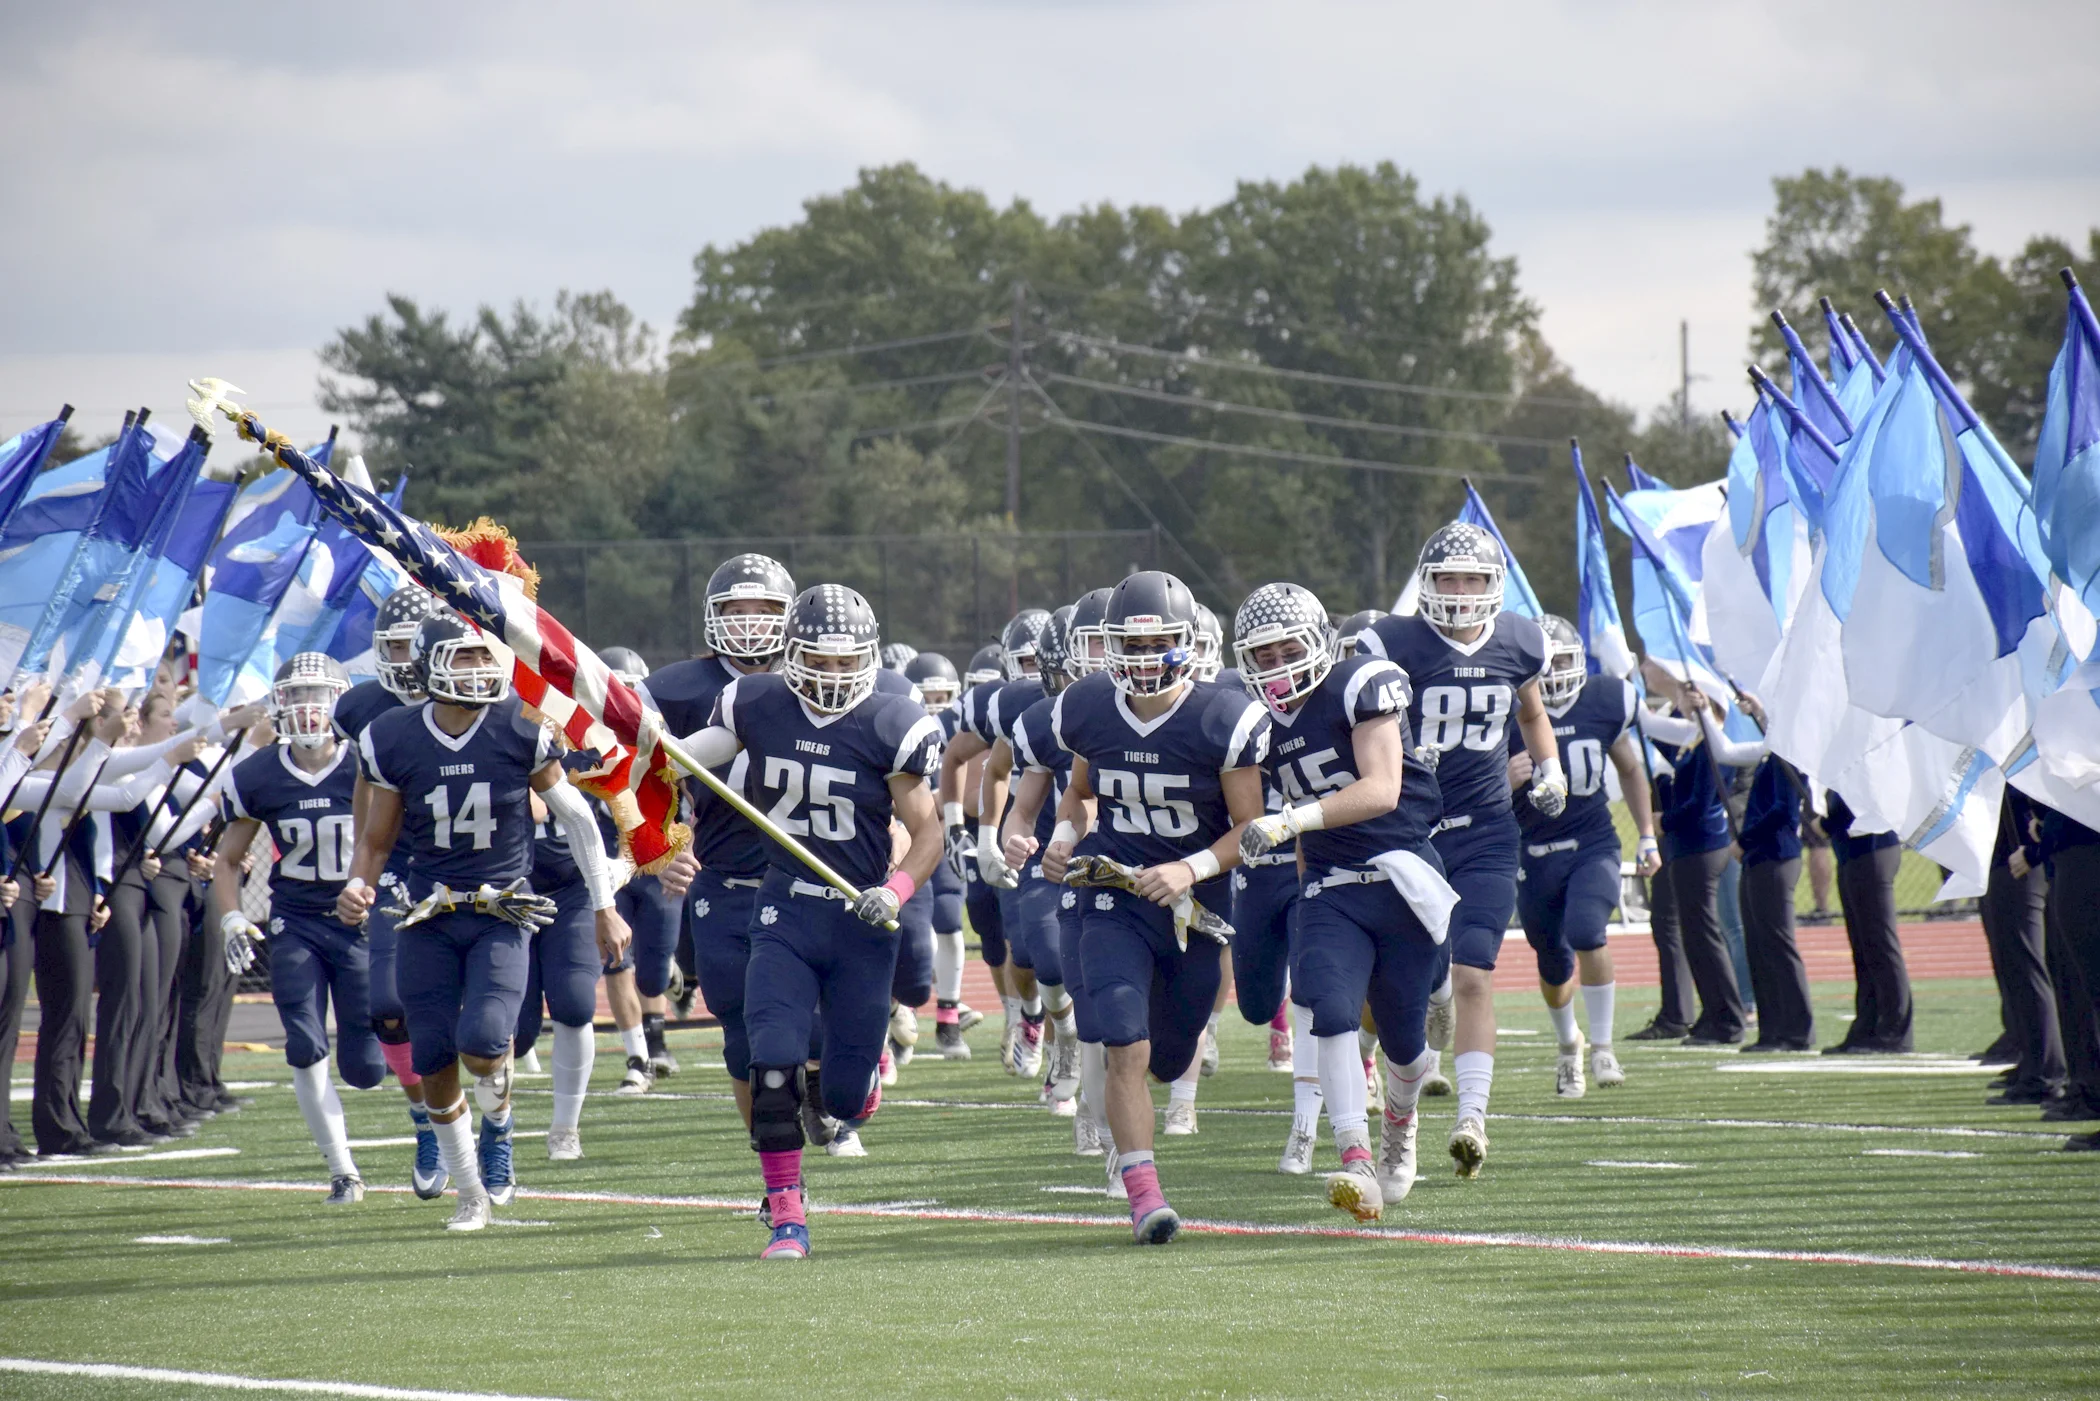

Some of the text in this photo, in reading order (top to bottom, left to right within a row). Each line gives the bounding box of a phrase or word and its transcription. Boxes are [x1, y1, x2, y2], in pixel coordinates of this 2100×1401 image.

[1255, 625, 1275, 634] Riddell
[1453, 667, 1486, 678] TIGERS
[1378, 679, 1409, 714] 45
[1420, 684, 1512, 752] 83
[795, 739, 831, 756] TIGERS
[1123, 750, 1160, 765] TIGERS
[1276, 735, 1306, 756] TIGERS
[439, 763, 475, 777] TIGERS
[1277, 747, 1357, 809] 45
[298, 797, 331, 810] TIGERS
[763, 755, 857, 841] 25
[1098, 768, 1200, 838] 35
[424, 782, 497, 850] 14
[278, 815, 354, 881] 20
